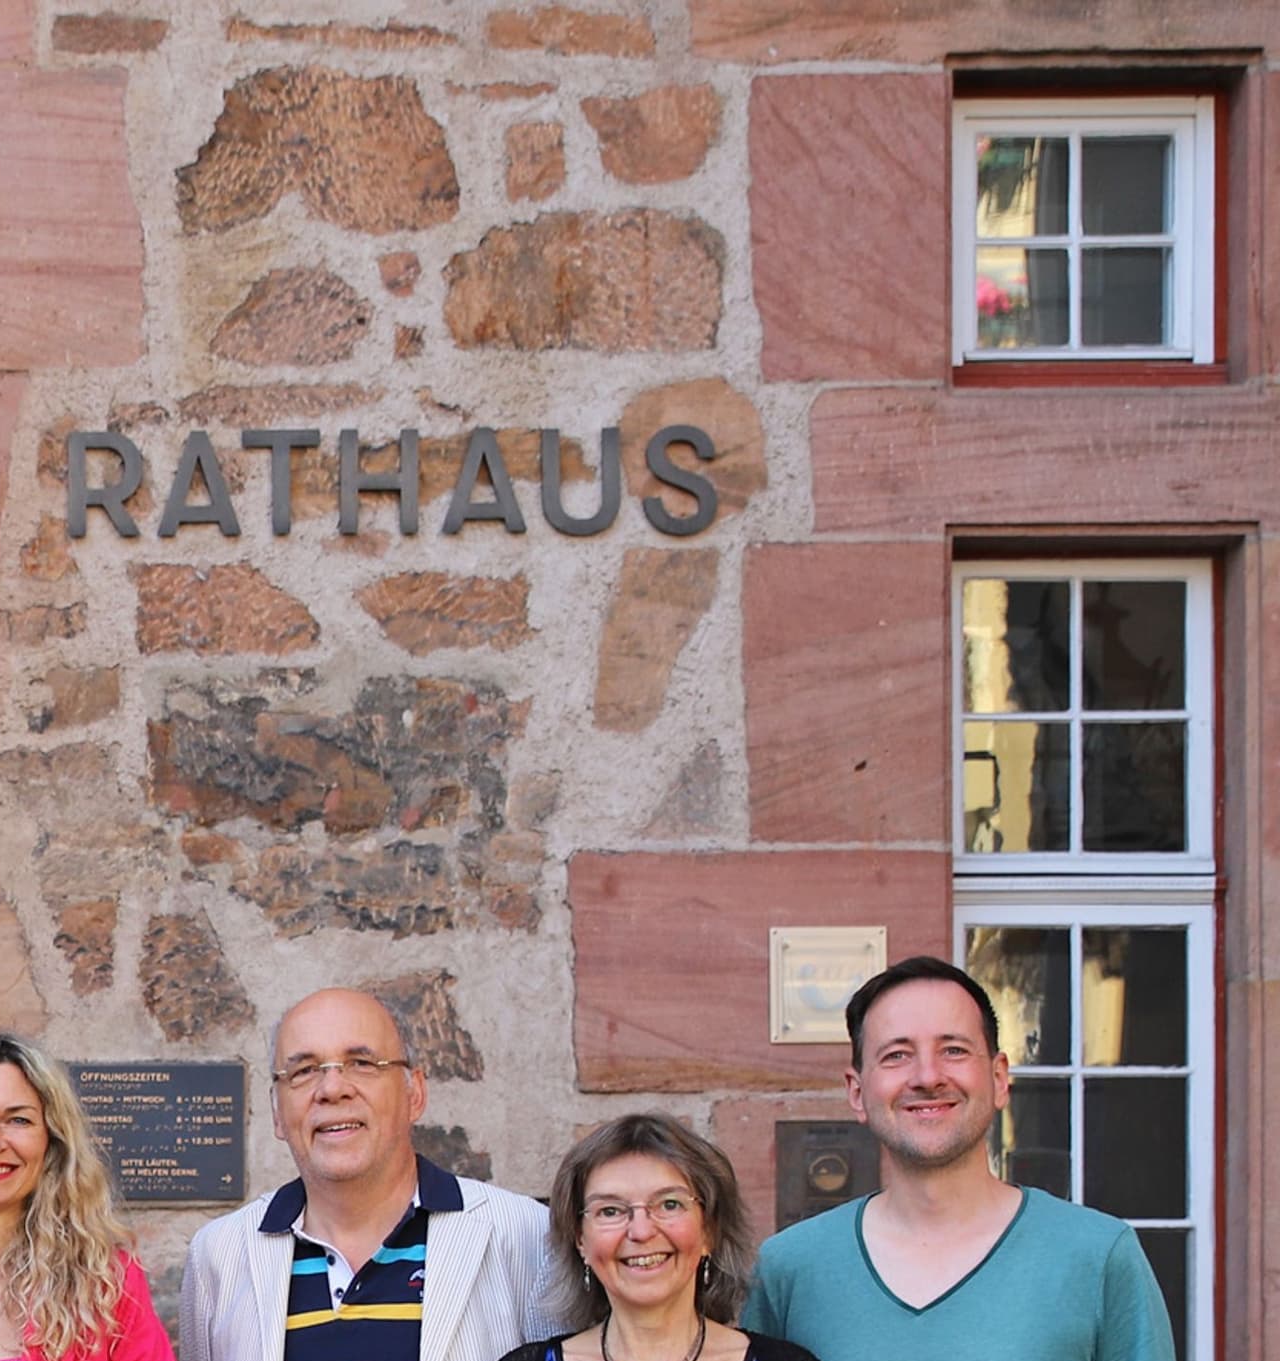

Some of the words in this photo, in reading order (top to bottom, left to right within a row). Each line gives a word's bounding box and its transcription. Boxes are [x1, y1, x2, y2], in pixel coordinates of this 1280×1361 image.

[67, 424, 718, 538] RATHAUS
[80, 1072, 170, 1082] ÖFFNUNGSZEITEN
[123, 1096, 165, 1105] MITTWOCH
[121, 1159, 143, 1167] BITTE
